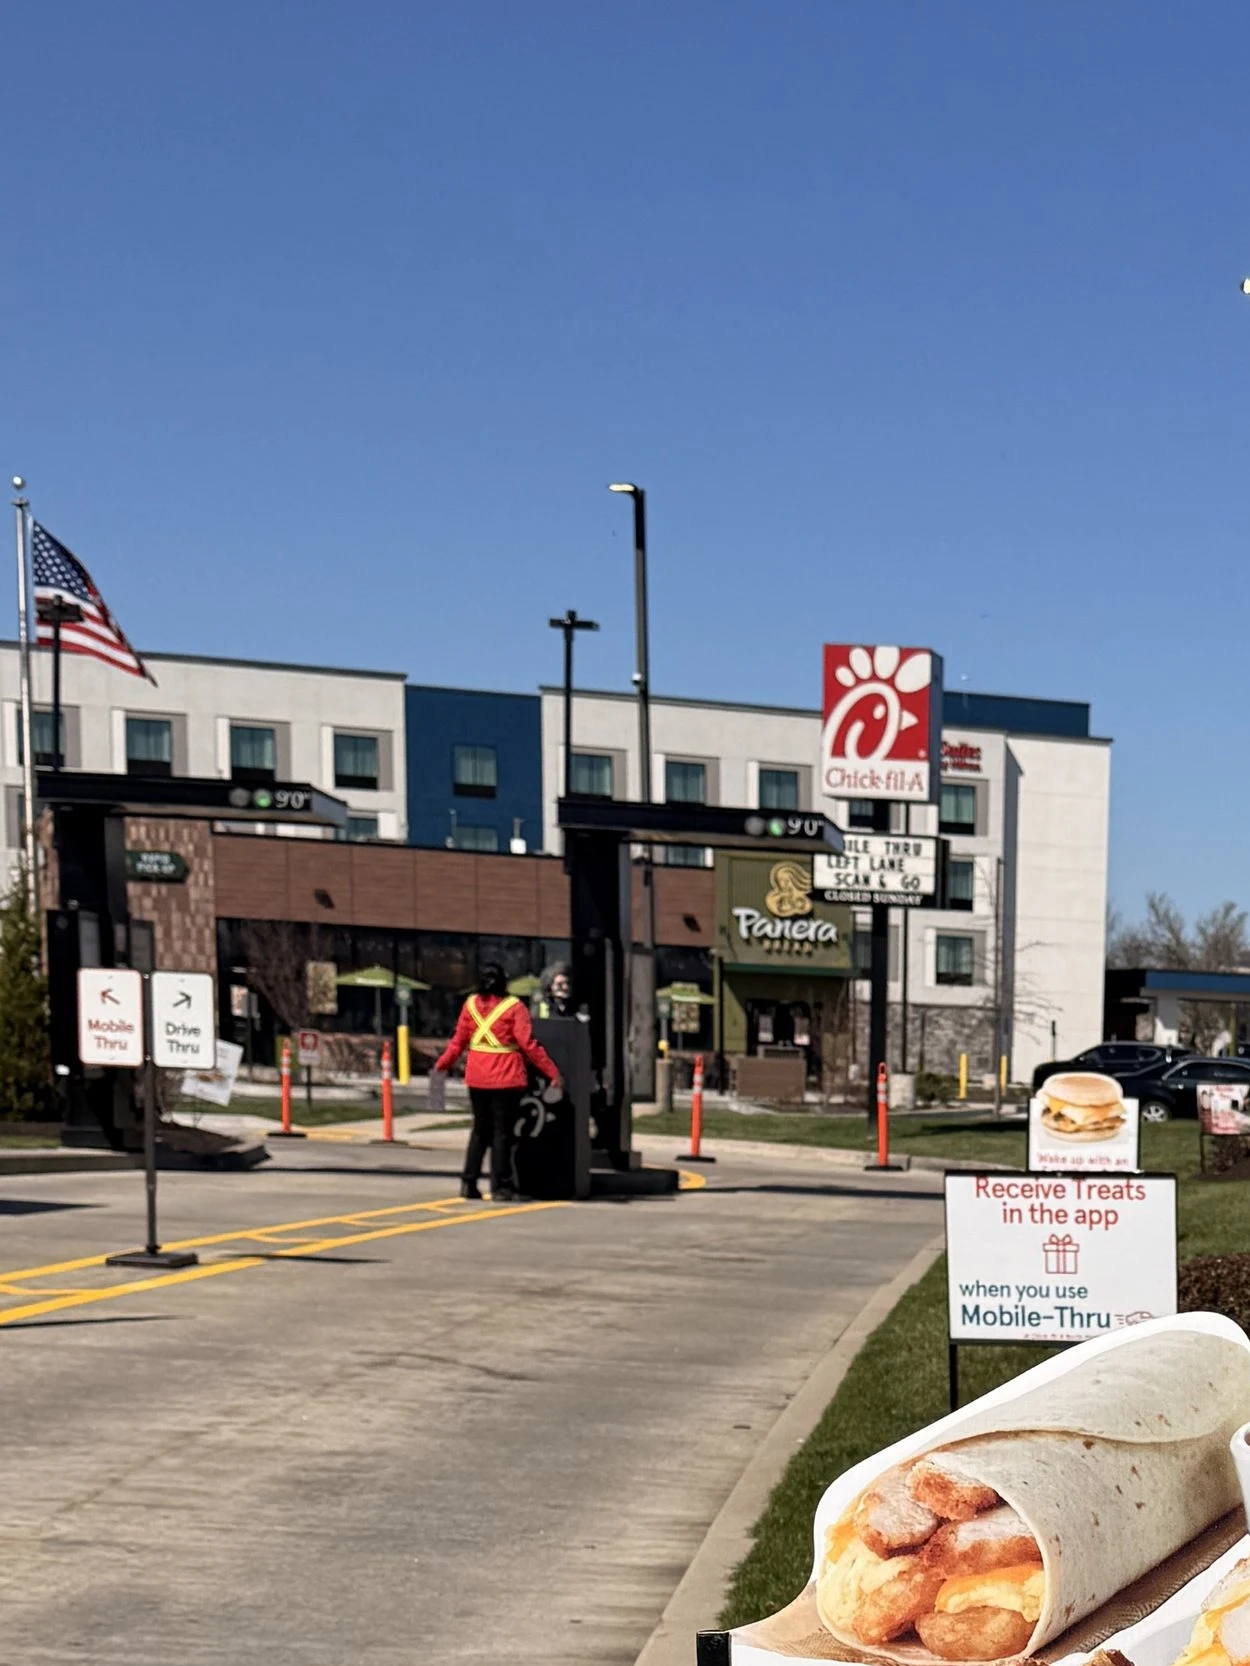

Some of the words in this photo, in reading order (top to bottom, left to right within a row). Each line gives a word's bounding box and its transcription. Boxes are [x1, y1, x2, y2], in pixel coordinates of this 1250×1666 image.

[825, 768, 924, 792] Chick-fil-A
[885, 841, 922, 856] THRU
[827, 855, 860, 869] LEFT
[870, 857, 904, 872] LANE
[834, 872, 870, 887] SCAN
[901, 874, 920, 890] GO
[824, 891, 872, 903] CLOSED
[873, 893, 924, 905] SUNDAY
[732, 907, 838, 942] Panera
[88, 1019, 134, 1033] Mobile
[165, 1022, 201, 1036] Drive
[94, 1036, 128, 1050] Thru
[167, 1039, 200, 1053] Thru
[1038, 1153, 1067, 1164] Wake
[1088, 1154, 1111, 1165] with
[976, 1177, 1066, 1199] Receive
[1072, 1177, 1146, 1200] Treats
[1002, 1202, 1023, 1224] in
[1029, 1203, 1068, 1225] the
[1074, 1208, 1119, 1230] app
[959, 1281, 1011, 1299] when
[1015, 1284, 1050, 1303] you
[1055, 1284, 1089, 1299] use
[961, 1304, 1111, 1329] Mobile-Thru
